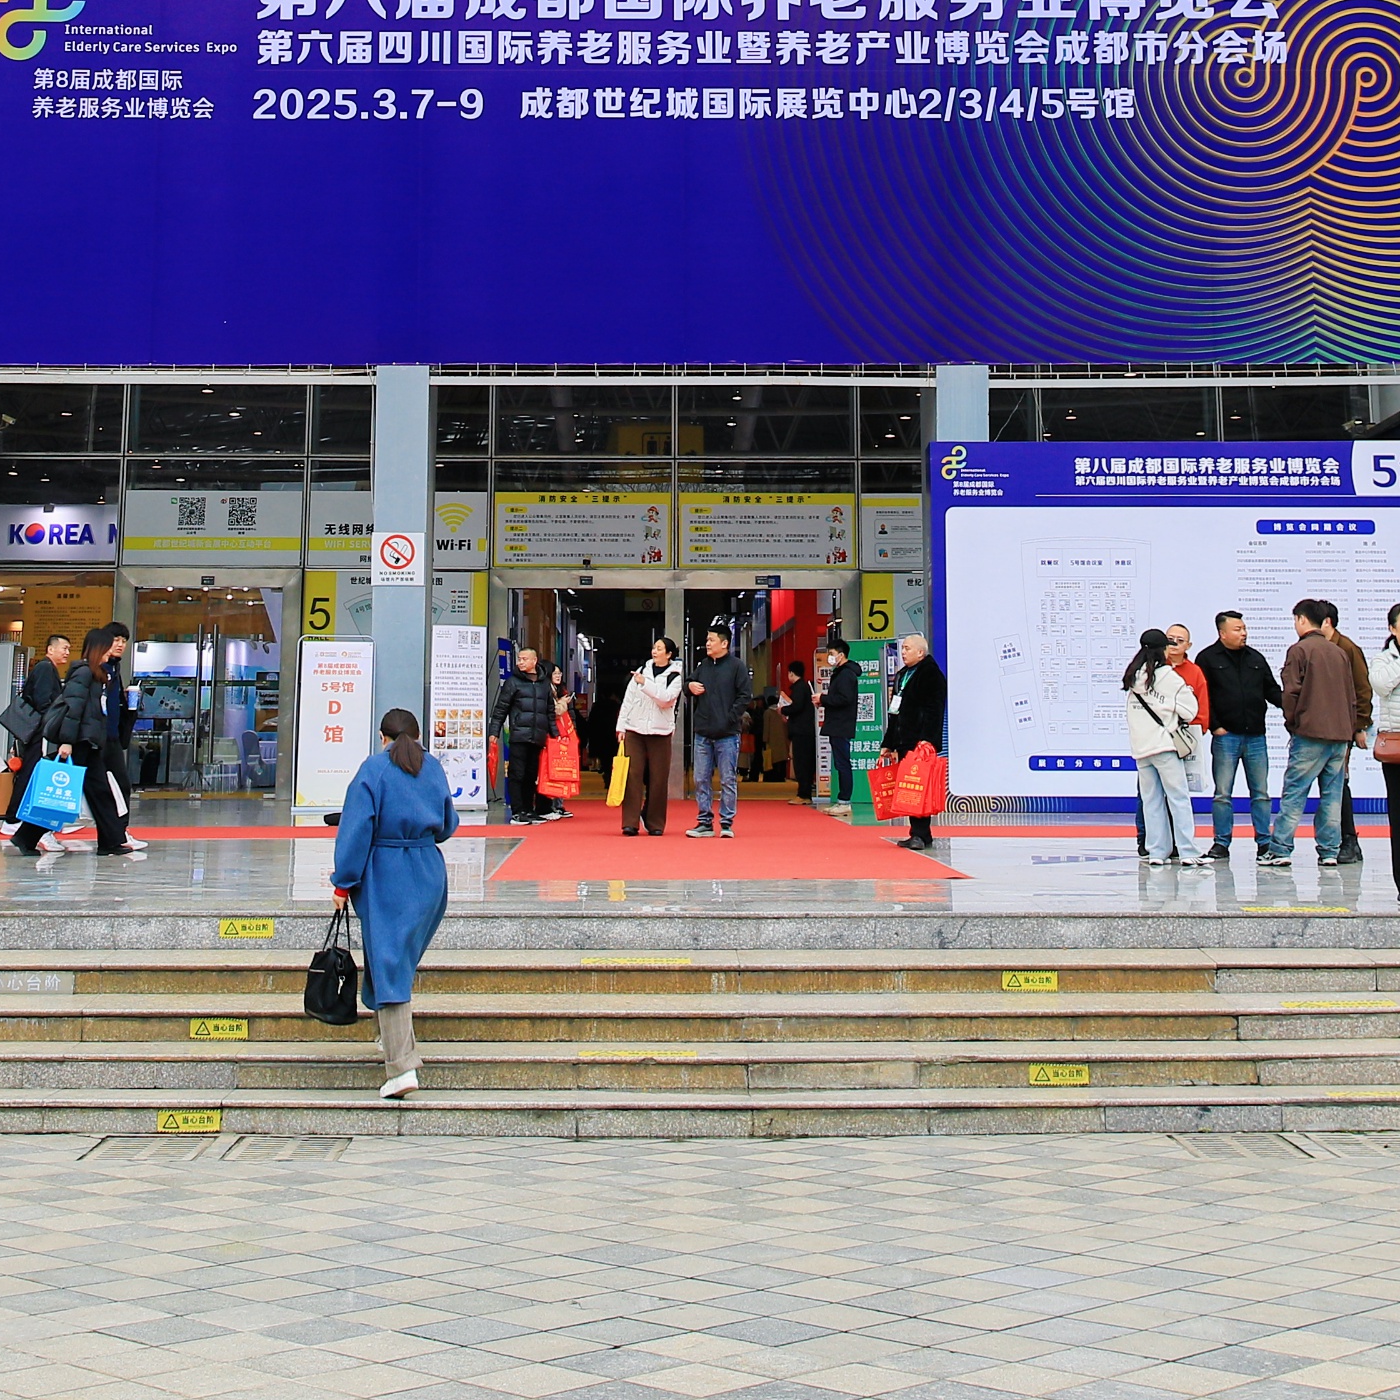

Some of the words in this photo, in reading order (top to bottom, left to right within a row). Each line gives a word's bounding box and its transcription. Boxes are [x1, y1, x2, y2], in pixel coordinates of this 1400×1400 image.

[64, 24, 153, 36] International
[64, 41, 110, 55] Elderly
[113, 42, 142, 53] Care
[144, 42, 200, 53] Services
[206, 42, 238, 55] Expo
[256, 29, 1288, 66] 第六届四川国际养老服务业暨养老产业博览会成都市分会场
[33, 68, 183, 91] 第8届成都国际
[32, 96, 214, 119] 养老服务业博览会
[252, 88, 485, 121] 2025.3.7-9
[519, 86, 1136, 123] 成都世纪城国际展览中心2/3/4/5号馆
[1074, 457, 1340, 474] 第八届成都国际养老服务业博览会
[1372, 454, 1397, 488] 5
[1075, 475, 1341, 487] 第六届四川国际养老服务业暨养老产业博览会成都市分会场
[309, 598, 331, 631] 5
[868, 600, 890, 633] 5
[321, 682, 354, 693] 5号馆
[328, 700, 342, 715] D
[323, 725, 344, 743] 馆
[241, 924, 268, 932] 当心台阶
[1023, 976, 1051, 984] 当心台阶
[213, 1024, 243, 1032] 当心台阶
[181, 1115, 214, 1125] 当心台阶
